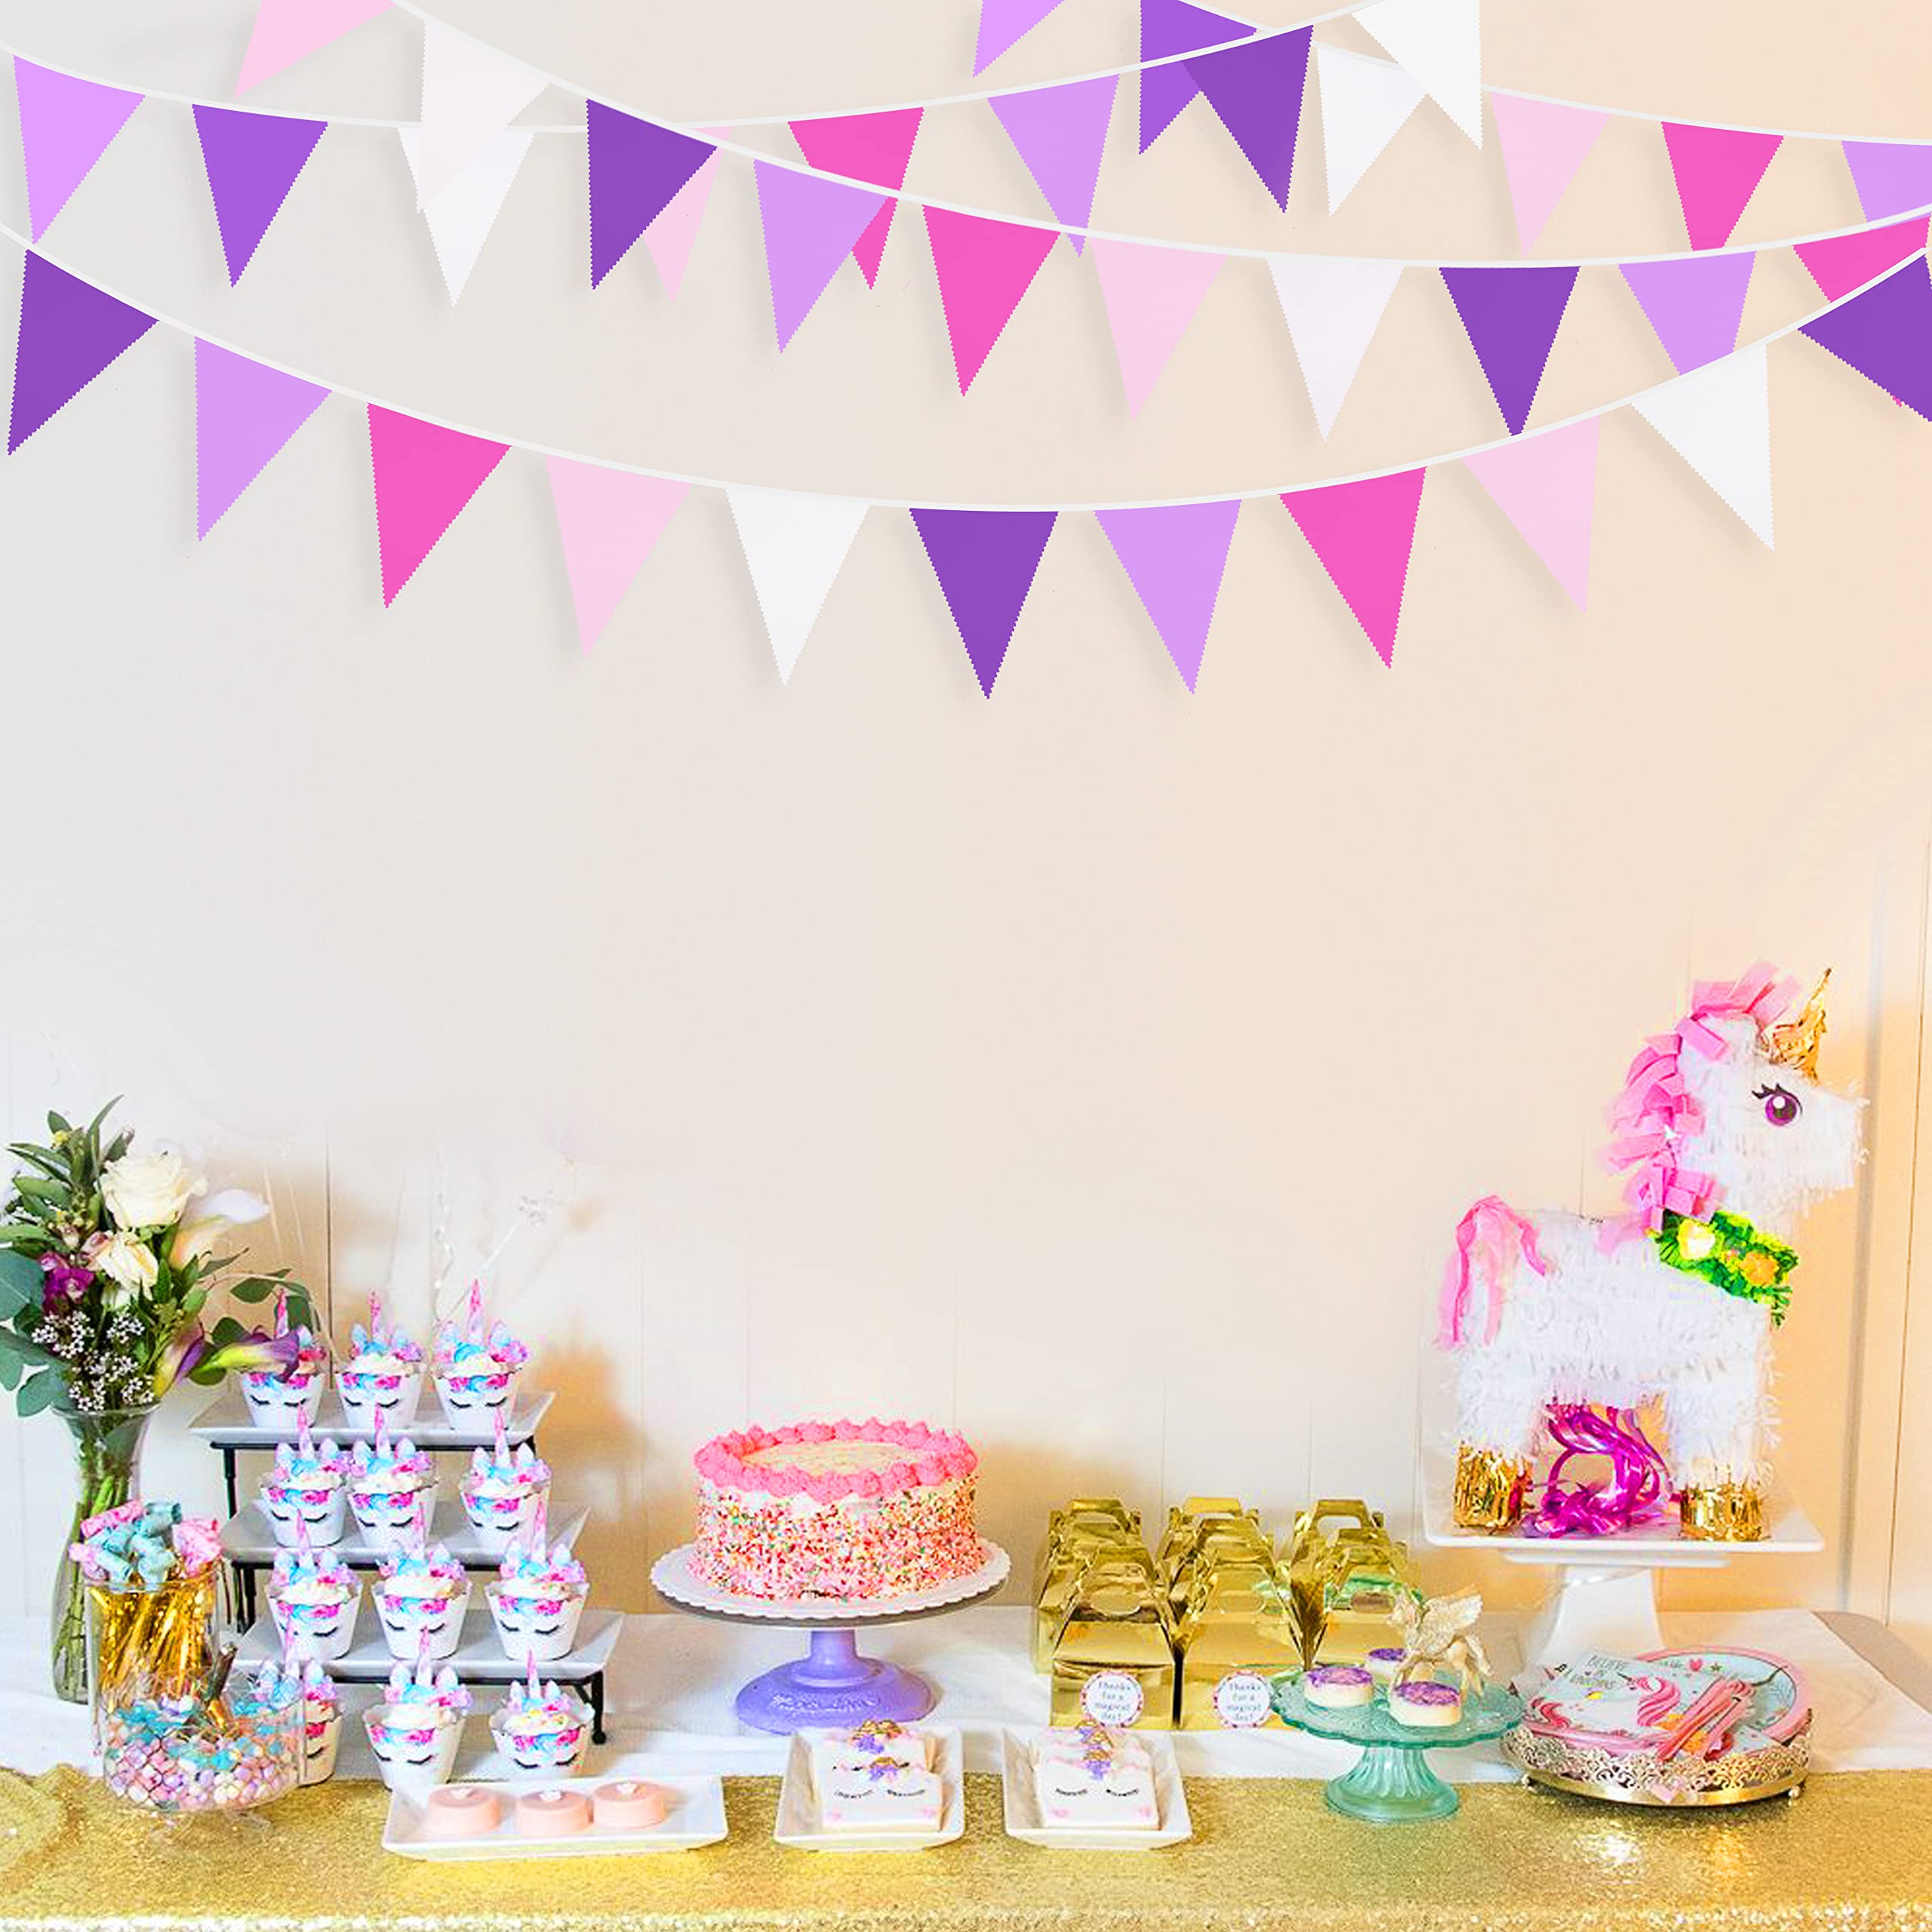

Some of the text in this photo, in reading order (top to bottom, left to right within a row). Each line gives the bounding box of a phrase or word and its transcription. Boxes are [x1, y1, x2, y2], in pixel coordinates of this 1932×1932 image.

[1097, 1681, 1131, 1690] Thanks
[1229, 1681, 1261, 1690] Thanks
[1101, 1691, 1116, 1700] for
[1232, 1692, 1247, 1702] for
[1094, 1702, 1131, 1712] magical
[1226, 1703, 1261, 1713] magical
